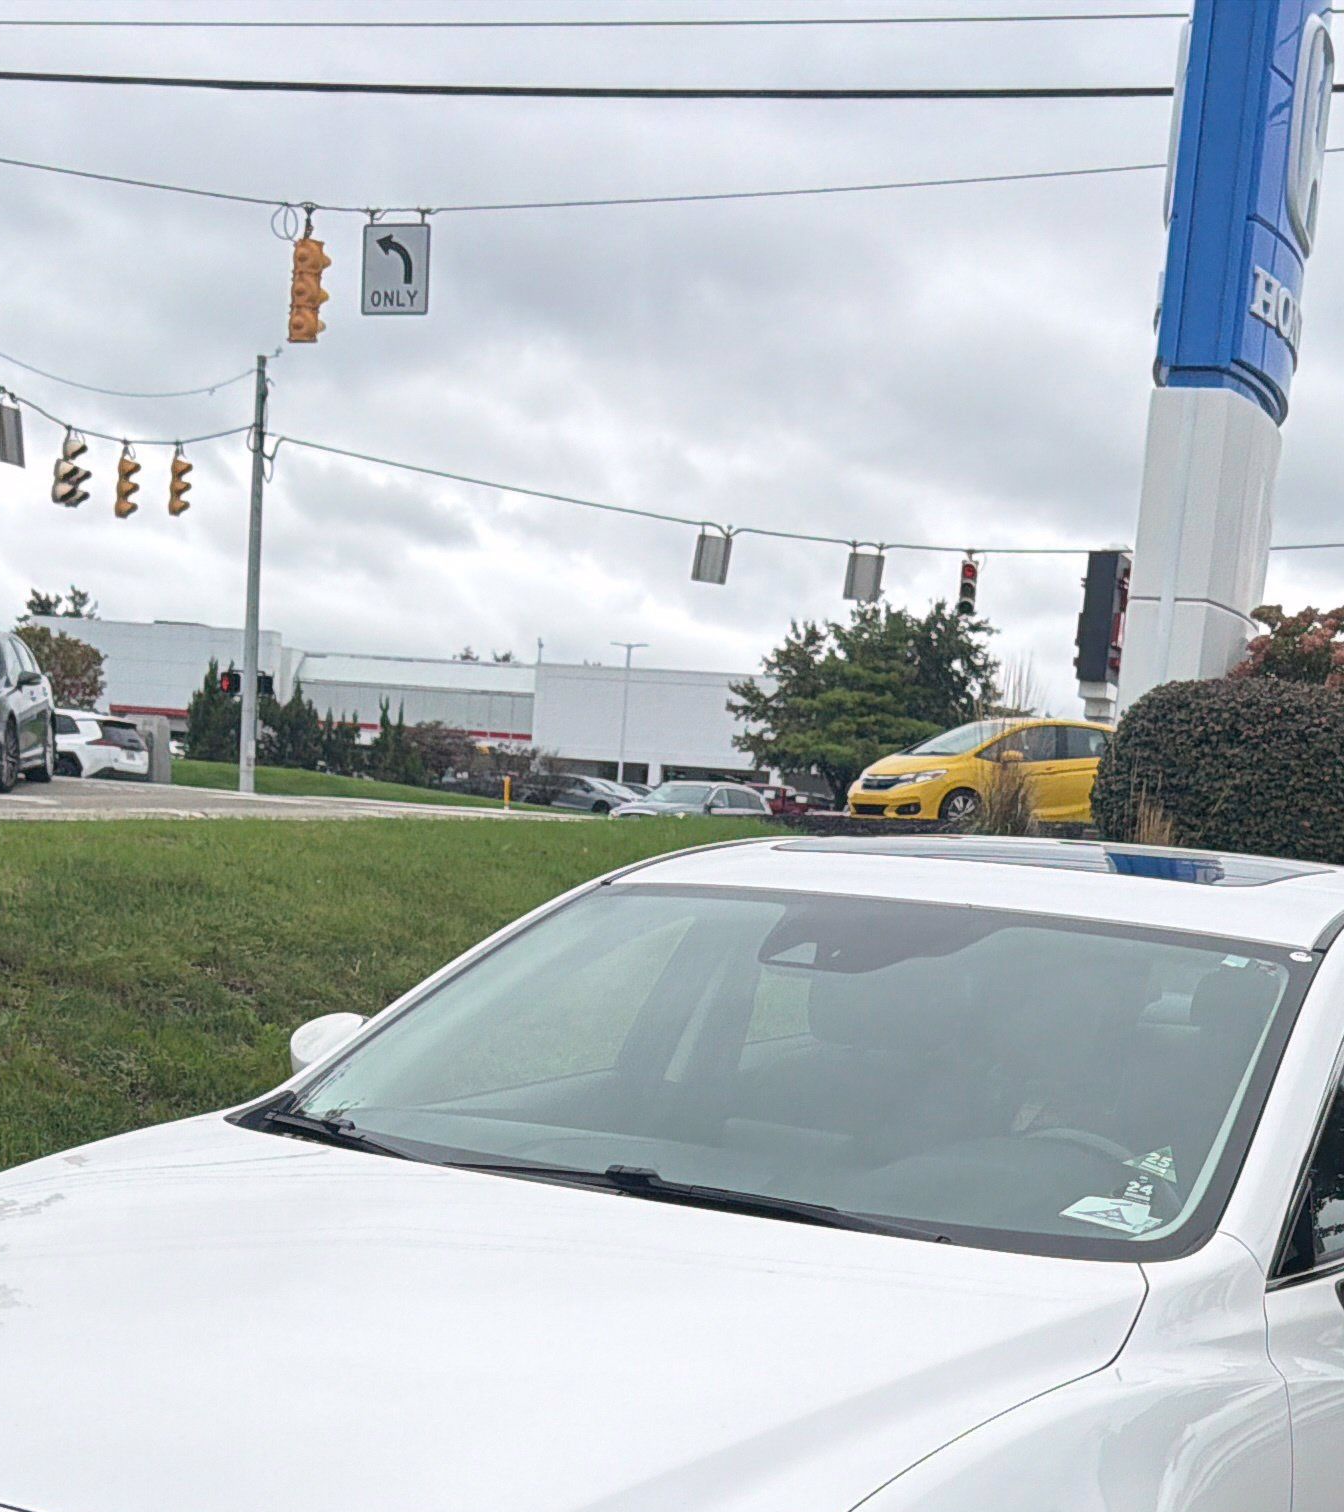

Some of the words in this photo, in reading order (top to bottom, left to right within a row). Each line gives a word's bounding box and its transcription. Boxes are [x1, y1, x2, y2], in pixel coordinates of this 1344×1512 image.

[370, 289, 418, 307] ONLY
[1144, 1151, 1173, 1169] 25
[1126, 1180, 1153, 1196] 24
